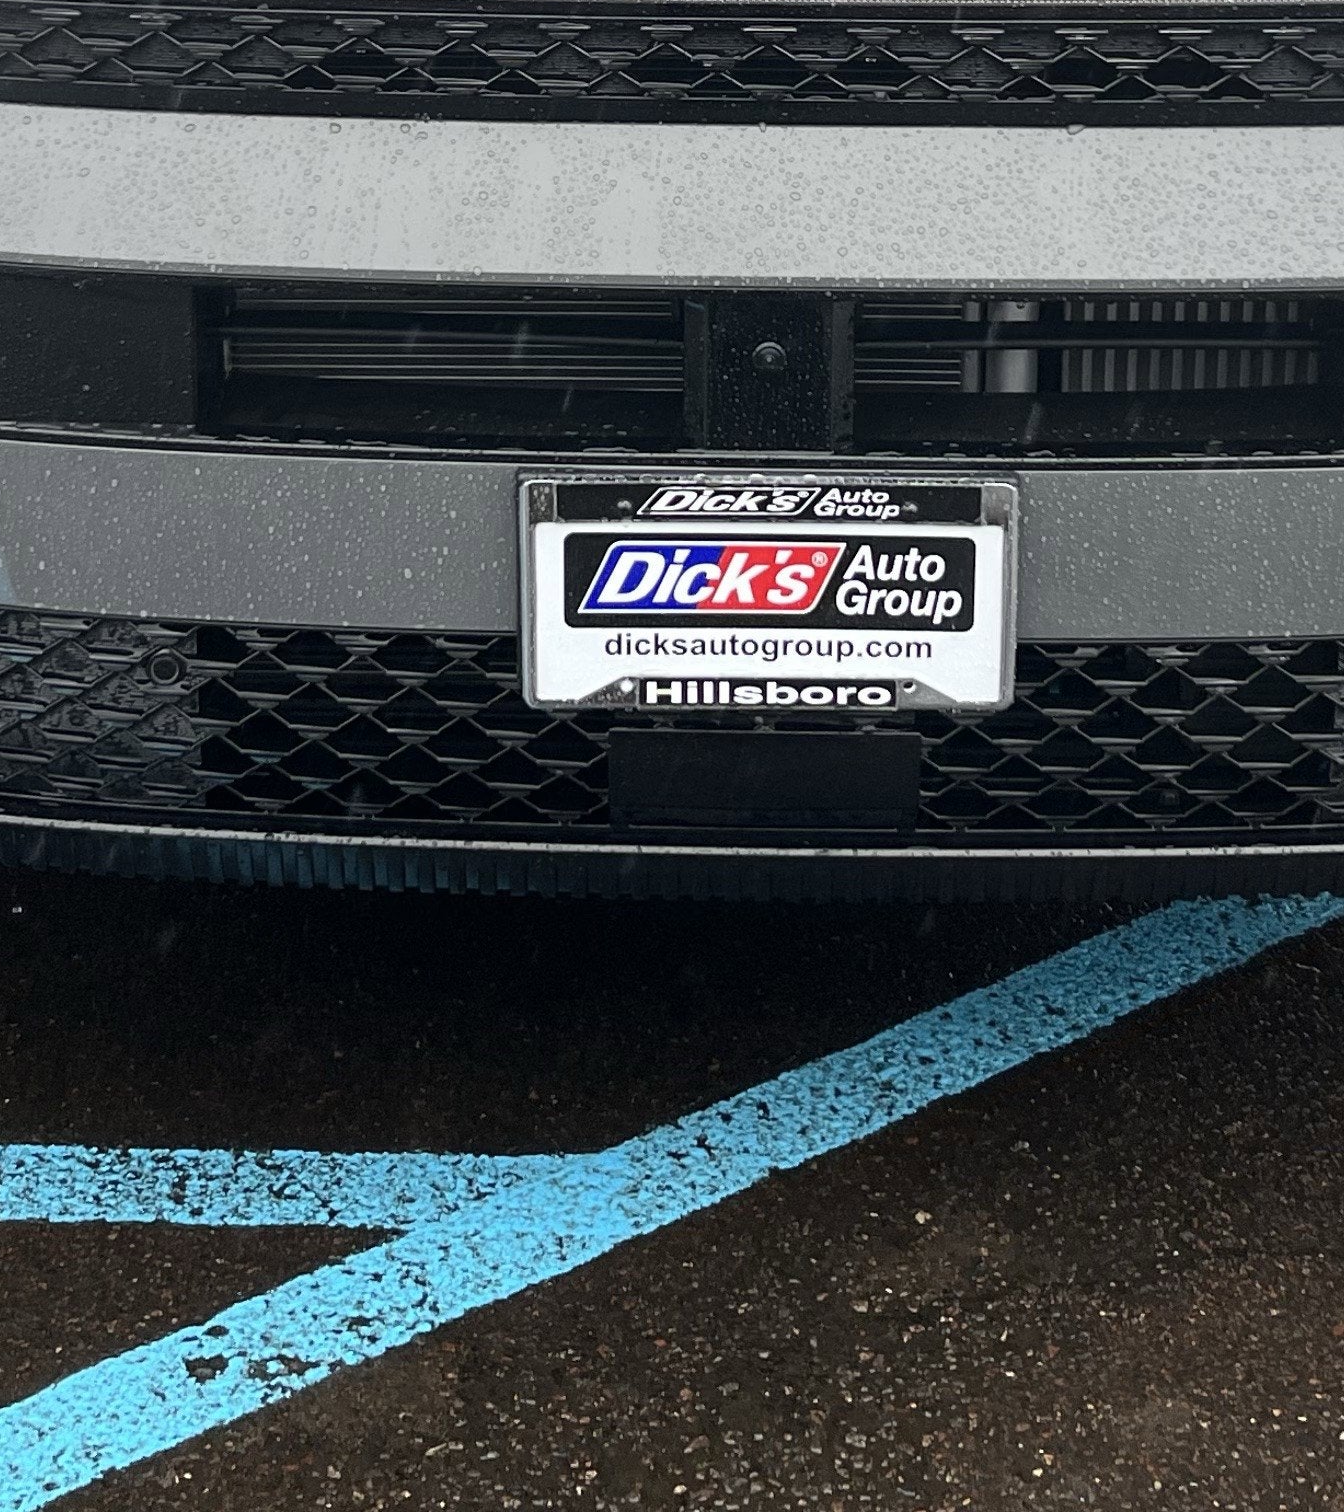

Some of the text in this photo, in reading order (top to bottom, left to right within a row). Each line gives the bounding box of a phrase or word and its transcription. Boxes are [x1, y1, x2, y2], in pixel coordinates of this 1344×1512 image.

[650, 488, 889, 512] Dick's Auto
[813, 501, 900, 520] Group
[597, 545, 946, 606] Dick's Auto
[835, 580, 963, 625] Group
[604, 632, 932, 662] dicksautogroup.com
[644, 680, 892, 706] Hillsboro
